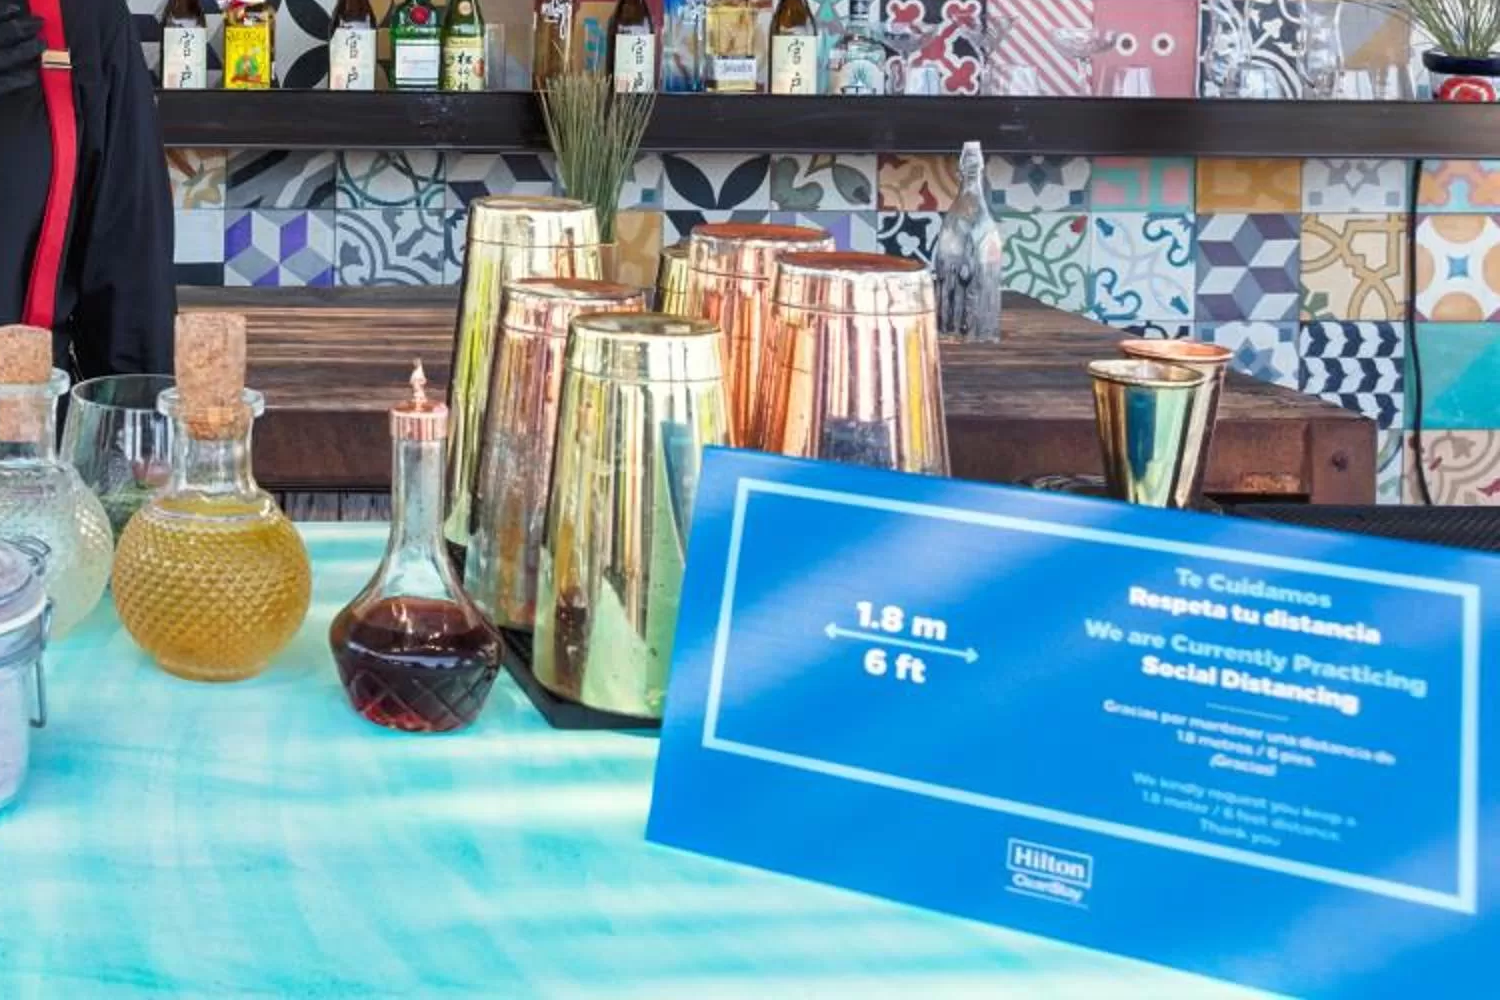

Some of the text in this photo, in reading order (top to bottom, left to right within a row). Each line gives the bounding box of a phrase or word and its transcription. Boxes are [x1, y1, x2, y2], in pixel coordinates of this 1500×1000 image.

[1175, 567, 1332, 608] Te Cuidamos
[856, 600, 947, 641] 1.8 m
[1128, 585, 1381, 646] Respeta tu distancia
[864, 648, 926, 684] 6 ft
[1084, 617, 1428, 699] We are Currently Practicing
[1141, 655, 1361, 717] Social Distancing
[1103, 699, 1159, 721] Gracias
[1160, 711, 1188, 725] por
[1188, 716, 1265, 740] mantener
[1197, 735, 1254, 757] metros
[1132, 771, 1157, 787] We
[1159, 776, 1205, 799] kindly
[1201, 816, 1247, 839] Thank
[1014, 846, 1085, 880] Hilton
